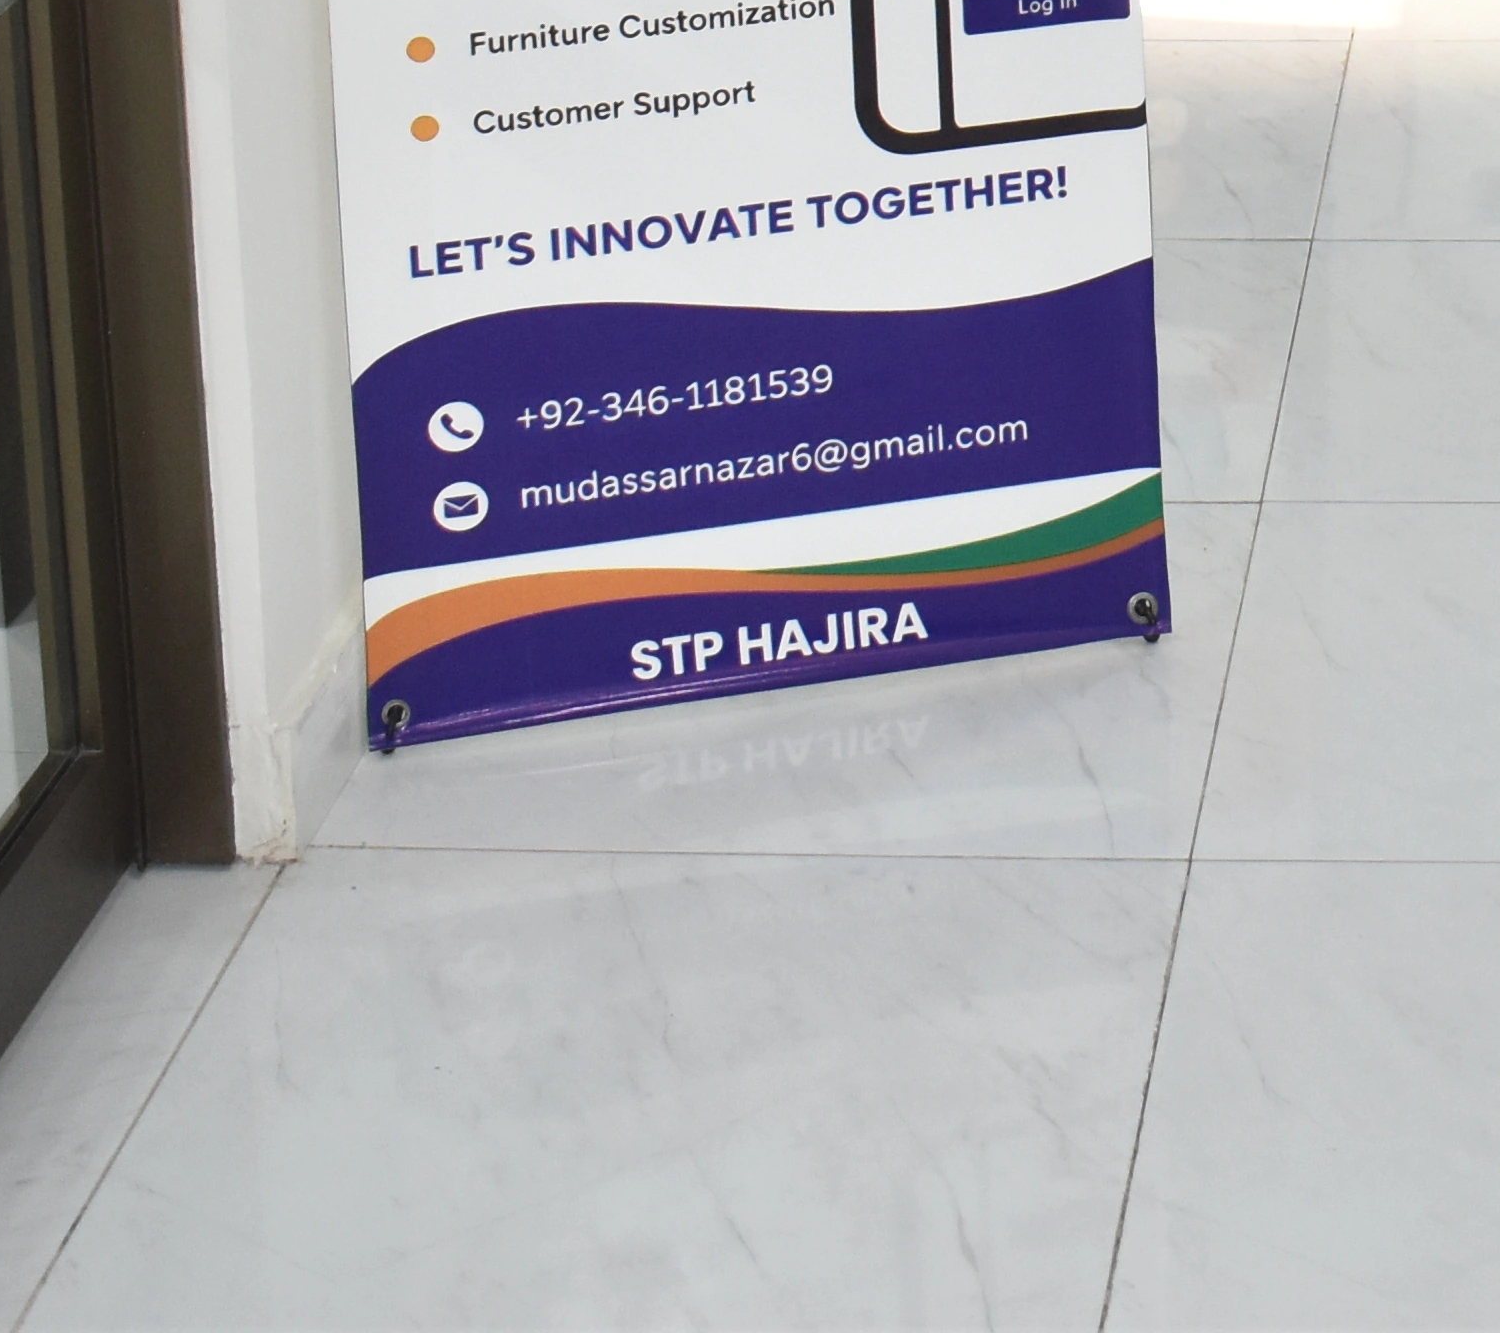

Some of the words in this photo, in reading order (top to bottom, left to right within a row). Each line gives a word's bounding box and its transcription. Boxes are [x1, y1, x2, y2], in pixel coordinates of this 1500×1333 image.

[469, 20, 611, 57] Furniture
[473, 97, 624, 135] Customer
[633, 80, 757, 119] Support
[408, 233, 536, 279] LET'S
[550, 199, 795, 262] INNOVATE
[806, 166, 1068, 231] TOGETHER!
[517, 364, 833, 431] +92-346-1181539
[521, 417, 1028, 511] mudassarnazar6@gmail.com
[631, 630, 722, 681] STP
[737, 602, 929, 666] HAJIRA
